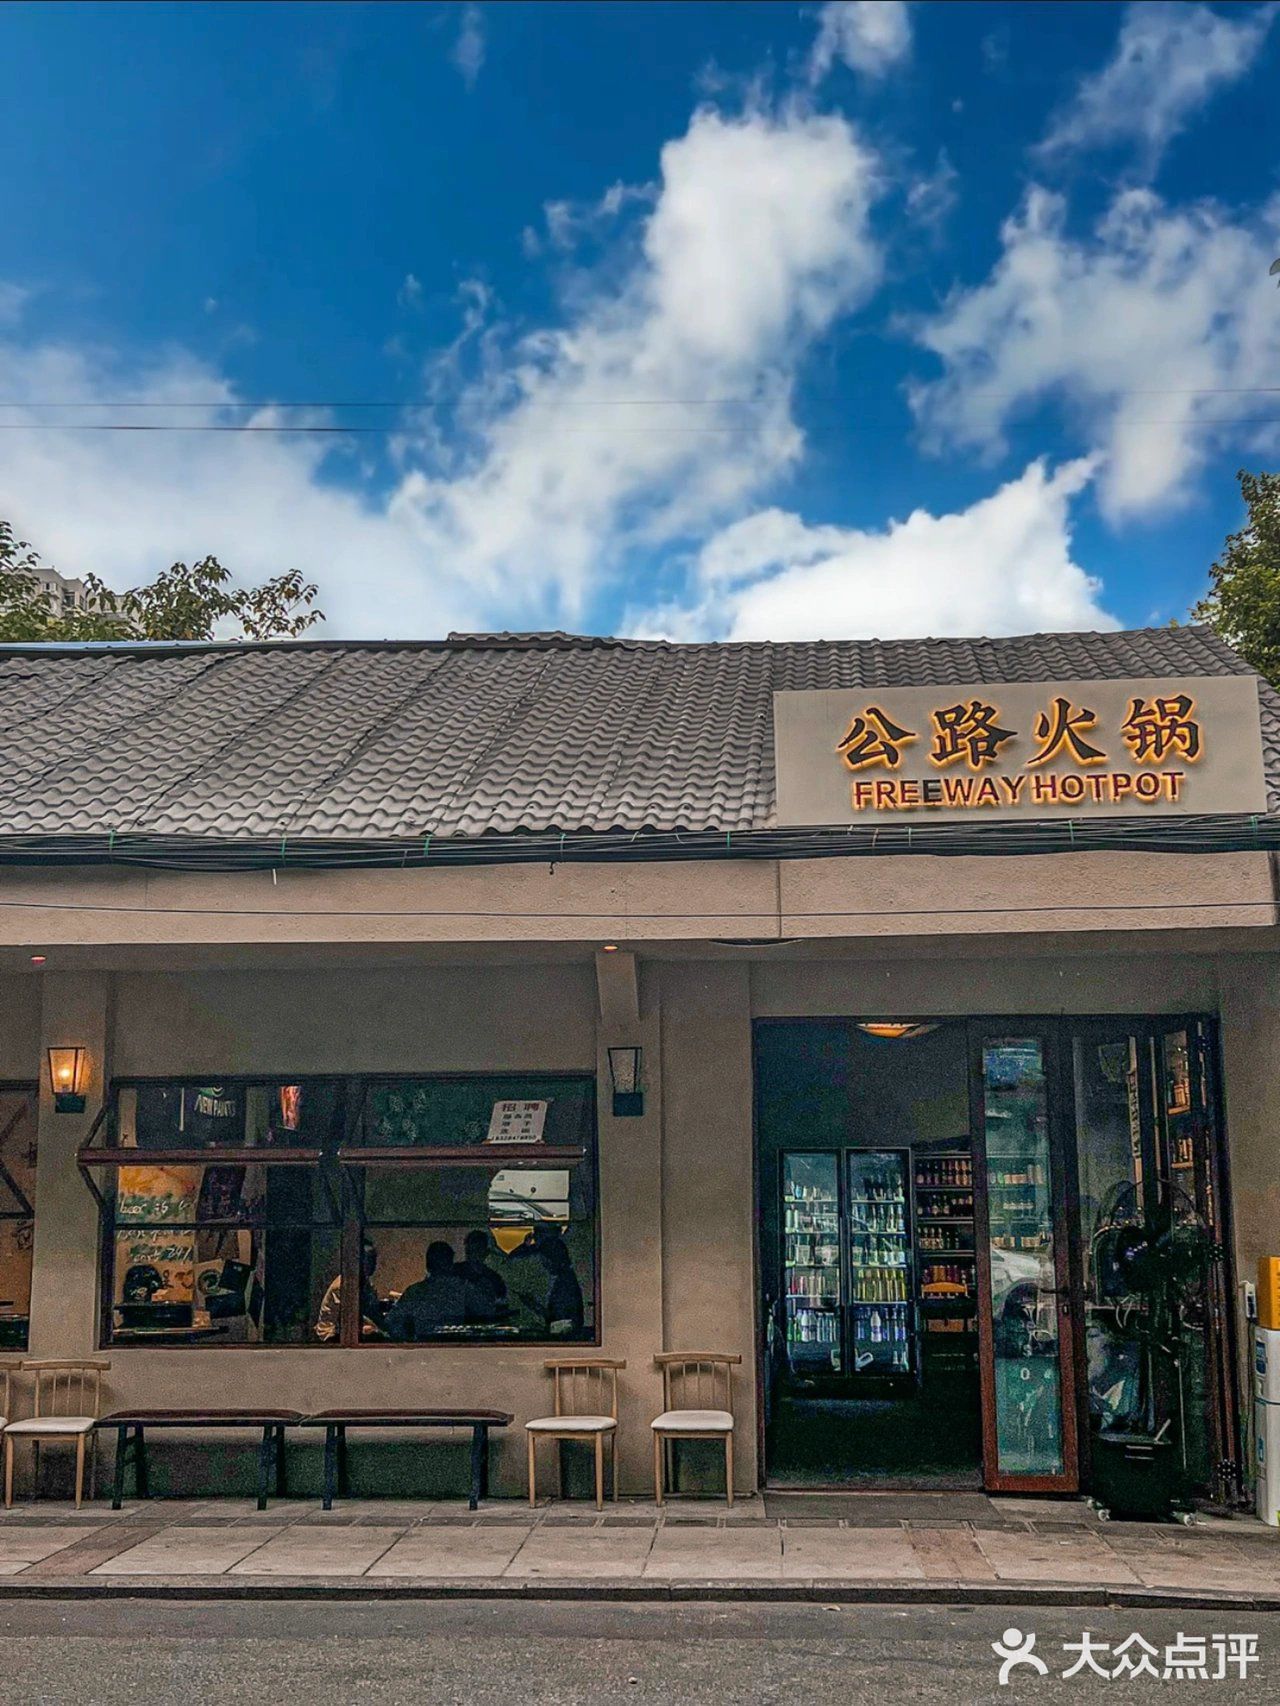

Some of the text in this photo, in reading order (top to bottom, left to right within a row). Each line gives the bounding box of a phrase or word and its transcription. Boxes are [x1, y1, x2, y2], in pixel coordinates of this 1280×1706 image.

[836, 695, 1199, 767] 公路火锅
[855, 771, 1184, 806] FREEWAY HOTPOT
